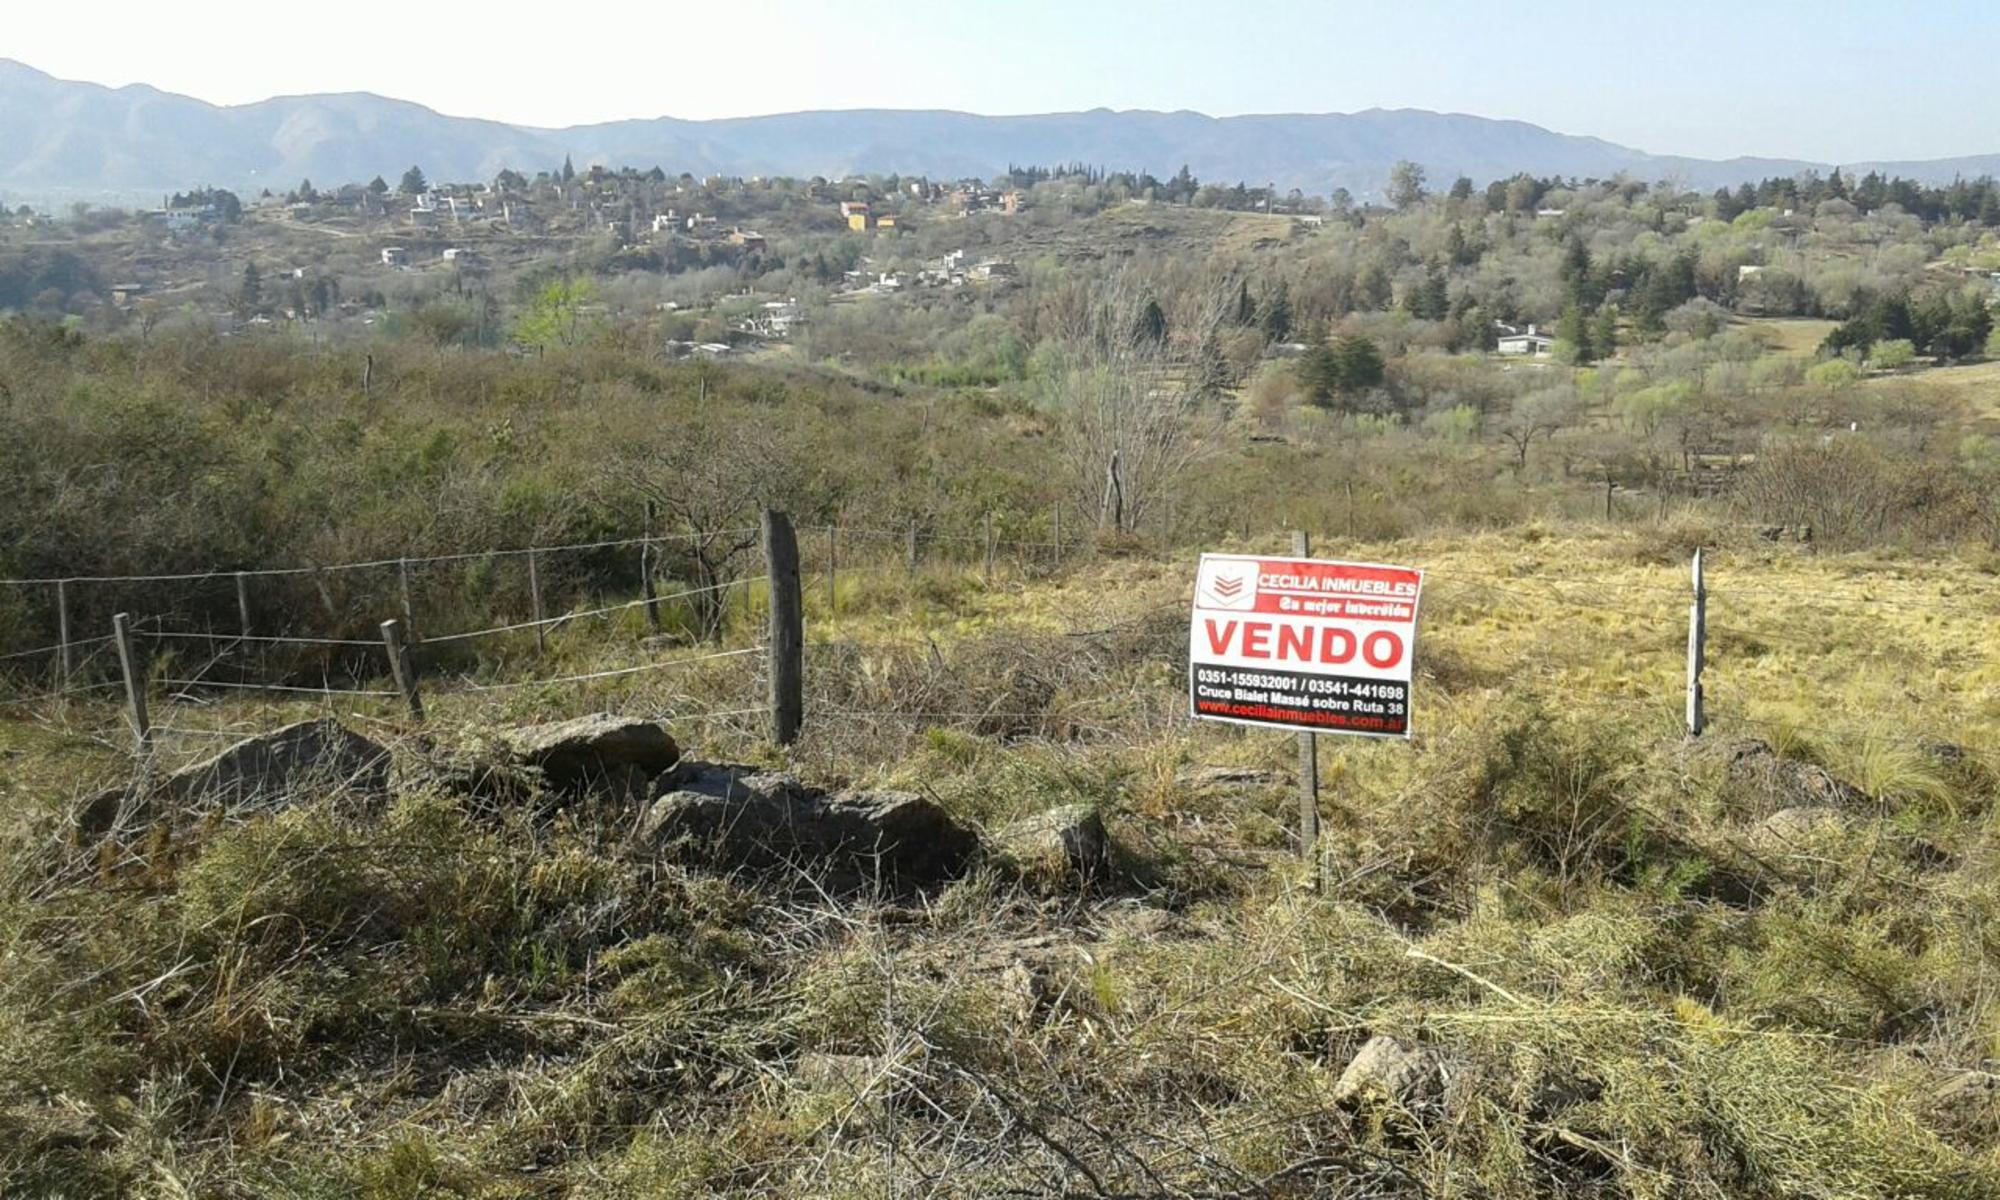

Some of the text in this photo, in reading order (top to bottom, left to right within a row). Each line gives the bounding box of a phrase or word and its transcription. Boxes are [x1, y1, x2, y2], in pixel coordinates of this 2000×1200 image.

[1258, 574, 1417, 596] CECILIA INMUEBLES
[1304, 598, 1341, 615] mejor
[1205, 619, 1403, 669] VENDO
[1198, 669, 1404, 700] 0351-155932001 / 03541-441698
[1198, 685, 1404, 715] Cruce Bialet Massé sobre Ruta 38
[1199, 700, 1404, 730] www.ceciliainmuebles.com.ar
